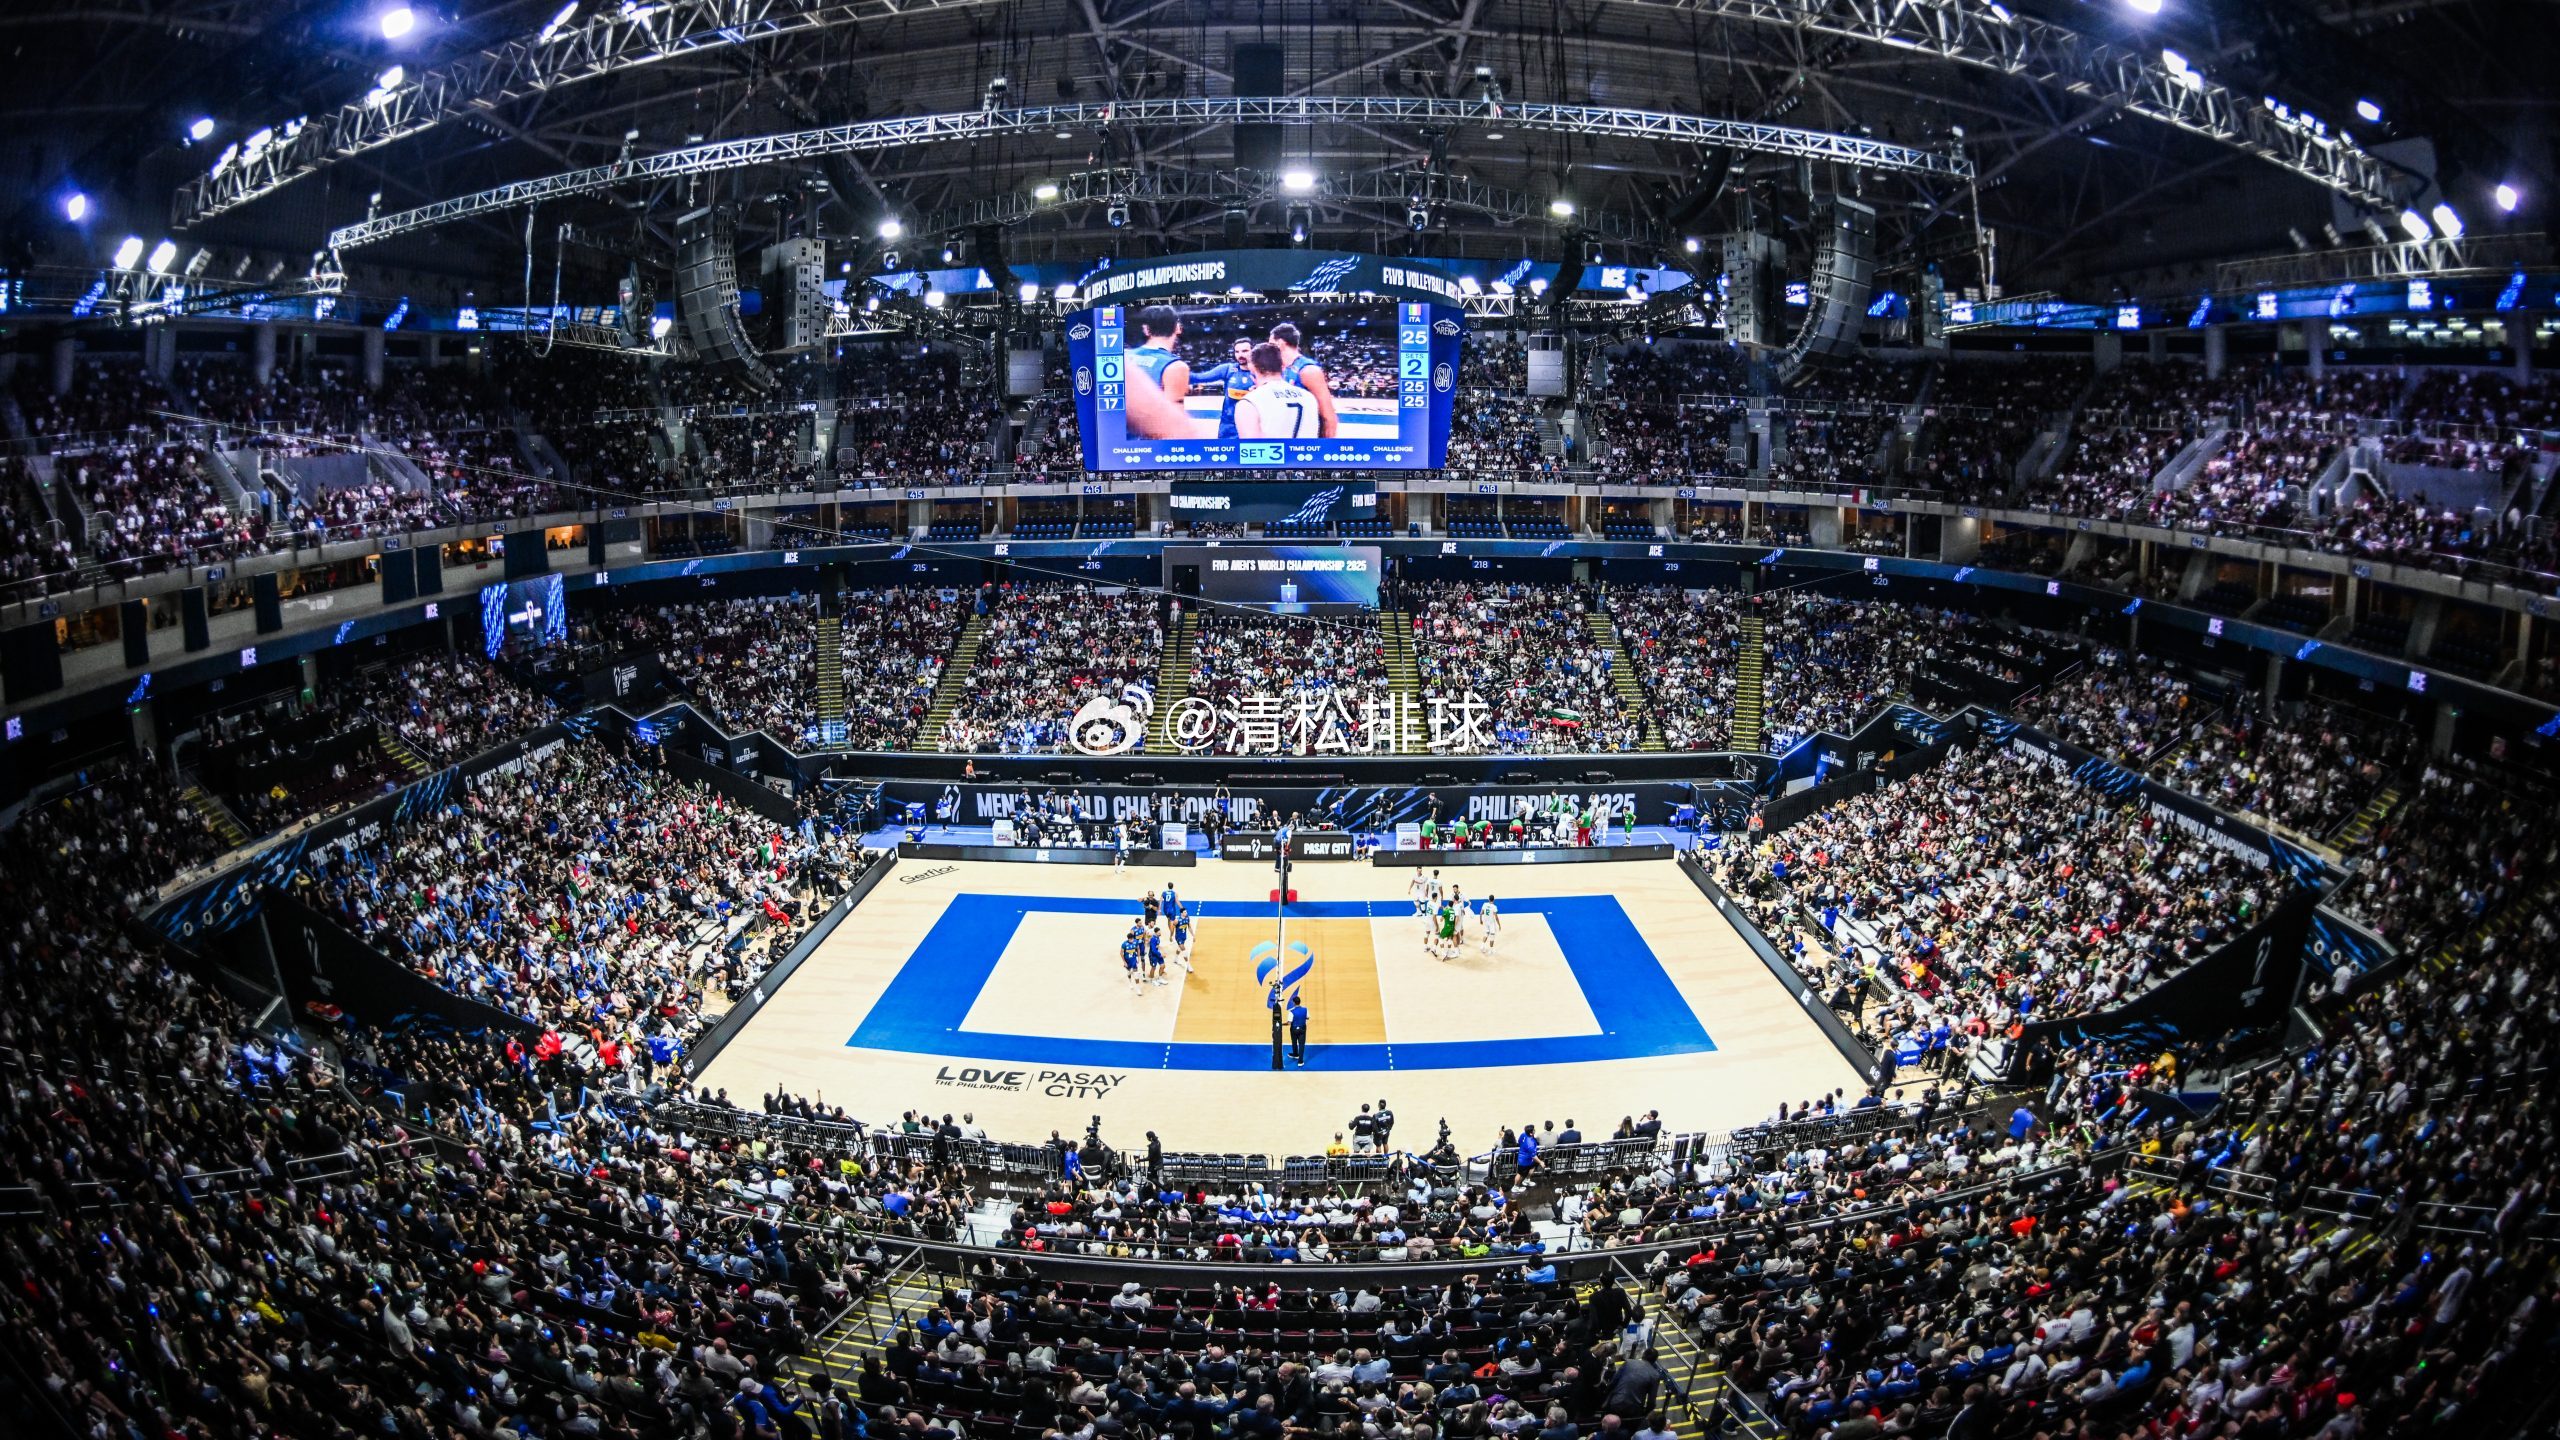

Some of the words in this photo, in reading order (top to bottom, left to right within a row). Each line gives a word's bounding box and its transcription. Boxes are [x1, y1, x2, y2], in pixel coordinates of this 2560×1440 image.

[1109, 272, 1135, 294] WORLD
[1136, 261, 1226, 288] CHAMPIONSHIPS
[1383, 266, 1404, 286] FIVB
[1406, 270, 1445, 295] VOLLEYBALL
[1101, 334, 1118, 348] 17
[1402, 331, 1427, 344] 25
[1103, 362, 1118, 378] 0
[1407, 359, 1422, 375] 2
[1103, 384, 1118, 394] 21
[1404, 381, 1424, 392] 25
[1104, 398, 1118, 410] 17
[1404, 396, 1424, 407] 25
[1240, 449, 1265, 458] SET
[1269, 445, 1283, 461] 3
[909, 491, 923, 499] 415
[1086, 486, 1100, 494] 416
[1481, 485, 1496, 493] 418
[1680, 490, 1694, 498] 419
[716, 501, 731, 509] 414B
[1179, 496, 1231, 510] CHAMPIONSHIPS
[994, 544, 1009, 556] ACE
[1442, 542, 1456, 554] ACE
[1649, 545, 1663, 556] ACE
[784, 552, 798, 563] ACE
[914, 564, 926, 572] 215
[1086, 562, 1100, 570] 216
[1212, 560, 1229, 571] FIVB
[1231, 560, 1256, 571] MEN'S
[1258, 560, 1285, 571] WORLD
[1286, 560, 1345, 571] CHAMPIONSHIP
[1346, 560, 1367, 571] 2025
[1474, 561, 1488, 569] 218
[1665, 563, 1678, 571] 219
[1864, 558, 1878, 570] ACE
[596, 572, 609, 584] AE
[702, 578, 716, 587] 214
[1873, 577, 1888, 586] 220
[1303, 843, 1327, 855] PASAY
[1331, 843, 1351, 855] CITY
[1522, 851, 1536, 862] ACE
[899, 866, 955, 882] Gerflor
[936, 1066, 1026, 1086] LOVE
[1038, 1070, 1126, 1087] PASAY
[935, 1079, 953, 1087] THE
[956, 1082, 1021, 1092] PHILIPPINES
[1044, 1085, 1111, 1100] CITY
